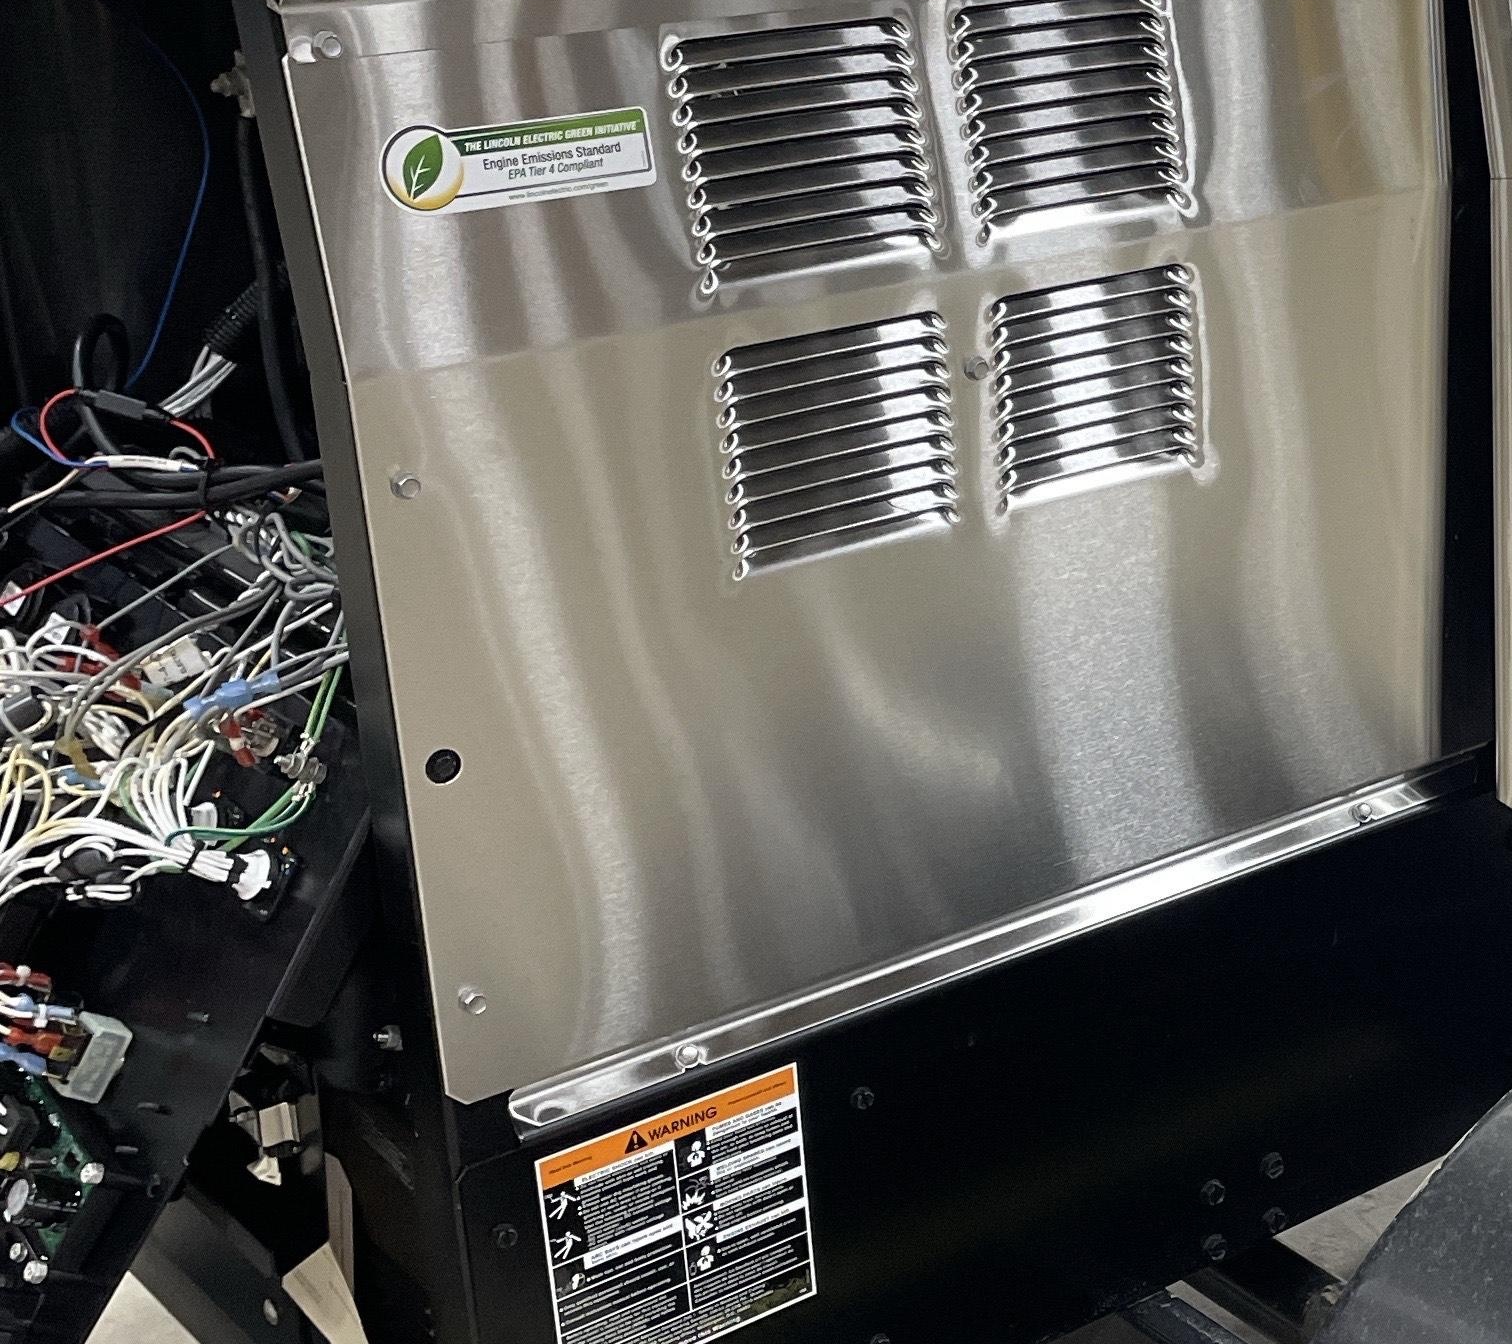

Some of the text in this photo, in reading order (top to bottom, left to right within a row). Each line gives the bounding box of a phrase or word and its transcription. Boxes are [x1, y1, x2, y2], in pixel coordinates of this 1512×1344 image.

[464, 140, 483, 153] THE
[483, 136, 521, 151] LINCOLN
[522, 131, 564, 147] ELECTRIC
[564, 126, 594, 141] GREEN
[483, 142, 622, 172] Engine Emissions Standard
[508, 158, 604, 181] EPA Tier 4 Compliant
[648, 1106, 718, 1143] WARNING
